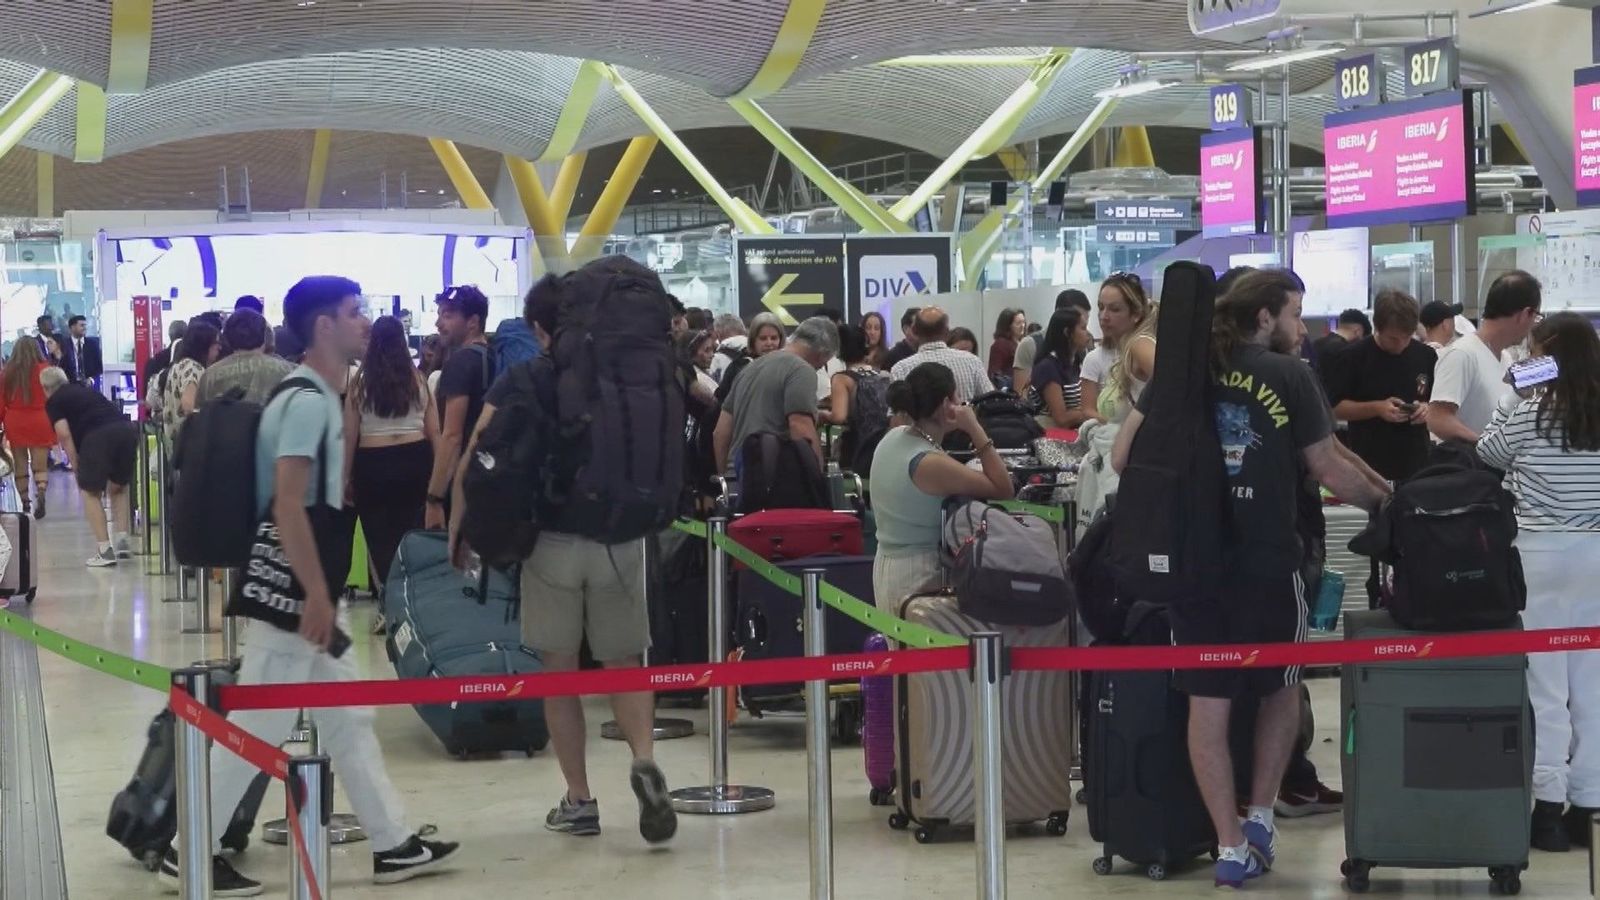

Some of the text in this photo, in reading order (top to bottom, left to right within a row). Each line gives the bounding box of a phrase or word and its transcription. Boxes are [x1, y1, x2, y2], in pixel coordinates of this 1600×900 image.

[1411, 50, 1441, 86] 817
[1341, 65, 1369, 99] 818
[1214, 91, 1237, 123] 819
[1404, 121, 1436, 139] IBERIA
[1337, 133, 1366, 149] IBERIA
[1210, 153, 1234, 167] IBERIA
[744, 248, 756, 256] VAT
[813, 256, 824, 264] de
[825, 256, 838, 264] IVA
[1256, 383, 1290, 429] VIVA
[1231, 486, 1254, 499] ER
[1548, 634, 1591, 645] IBERIA
[1374, 644, 1417, 655] IBERIA
[1200, 651, 1242, 662] IBERIA
[832, 660, 875, 672] IBERIA
[650, 672, 695, 684] IBERIA
[460, 683, 506, 694] IBERIA
